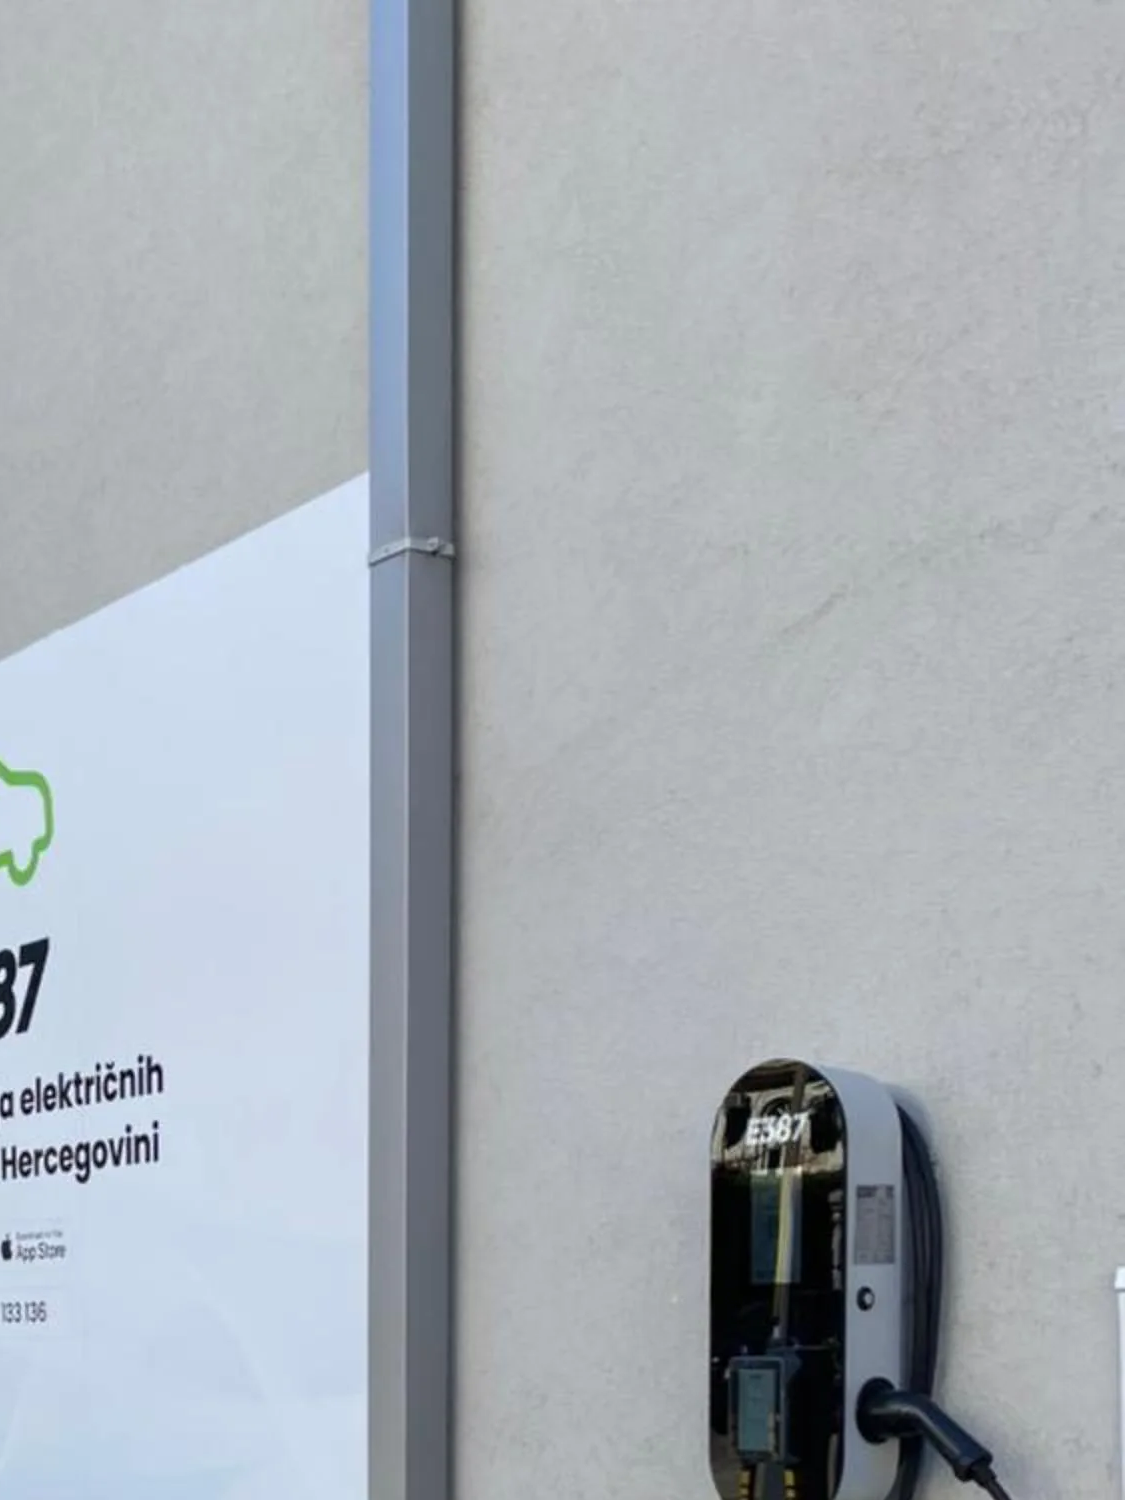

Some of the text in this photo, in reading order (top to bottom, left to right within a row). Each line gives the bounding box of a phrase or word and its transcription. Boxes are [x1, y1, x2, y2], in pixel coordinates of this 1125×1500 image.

[20, 1054, 164, 1116] električnih
[1, 1120, 159, 1184] Hercegovini
[746, 1112, 809, 1146] E387
[15, 1241, 66, 1263] App Store
